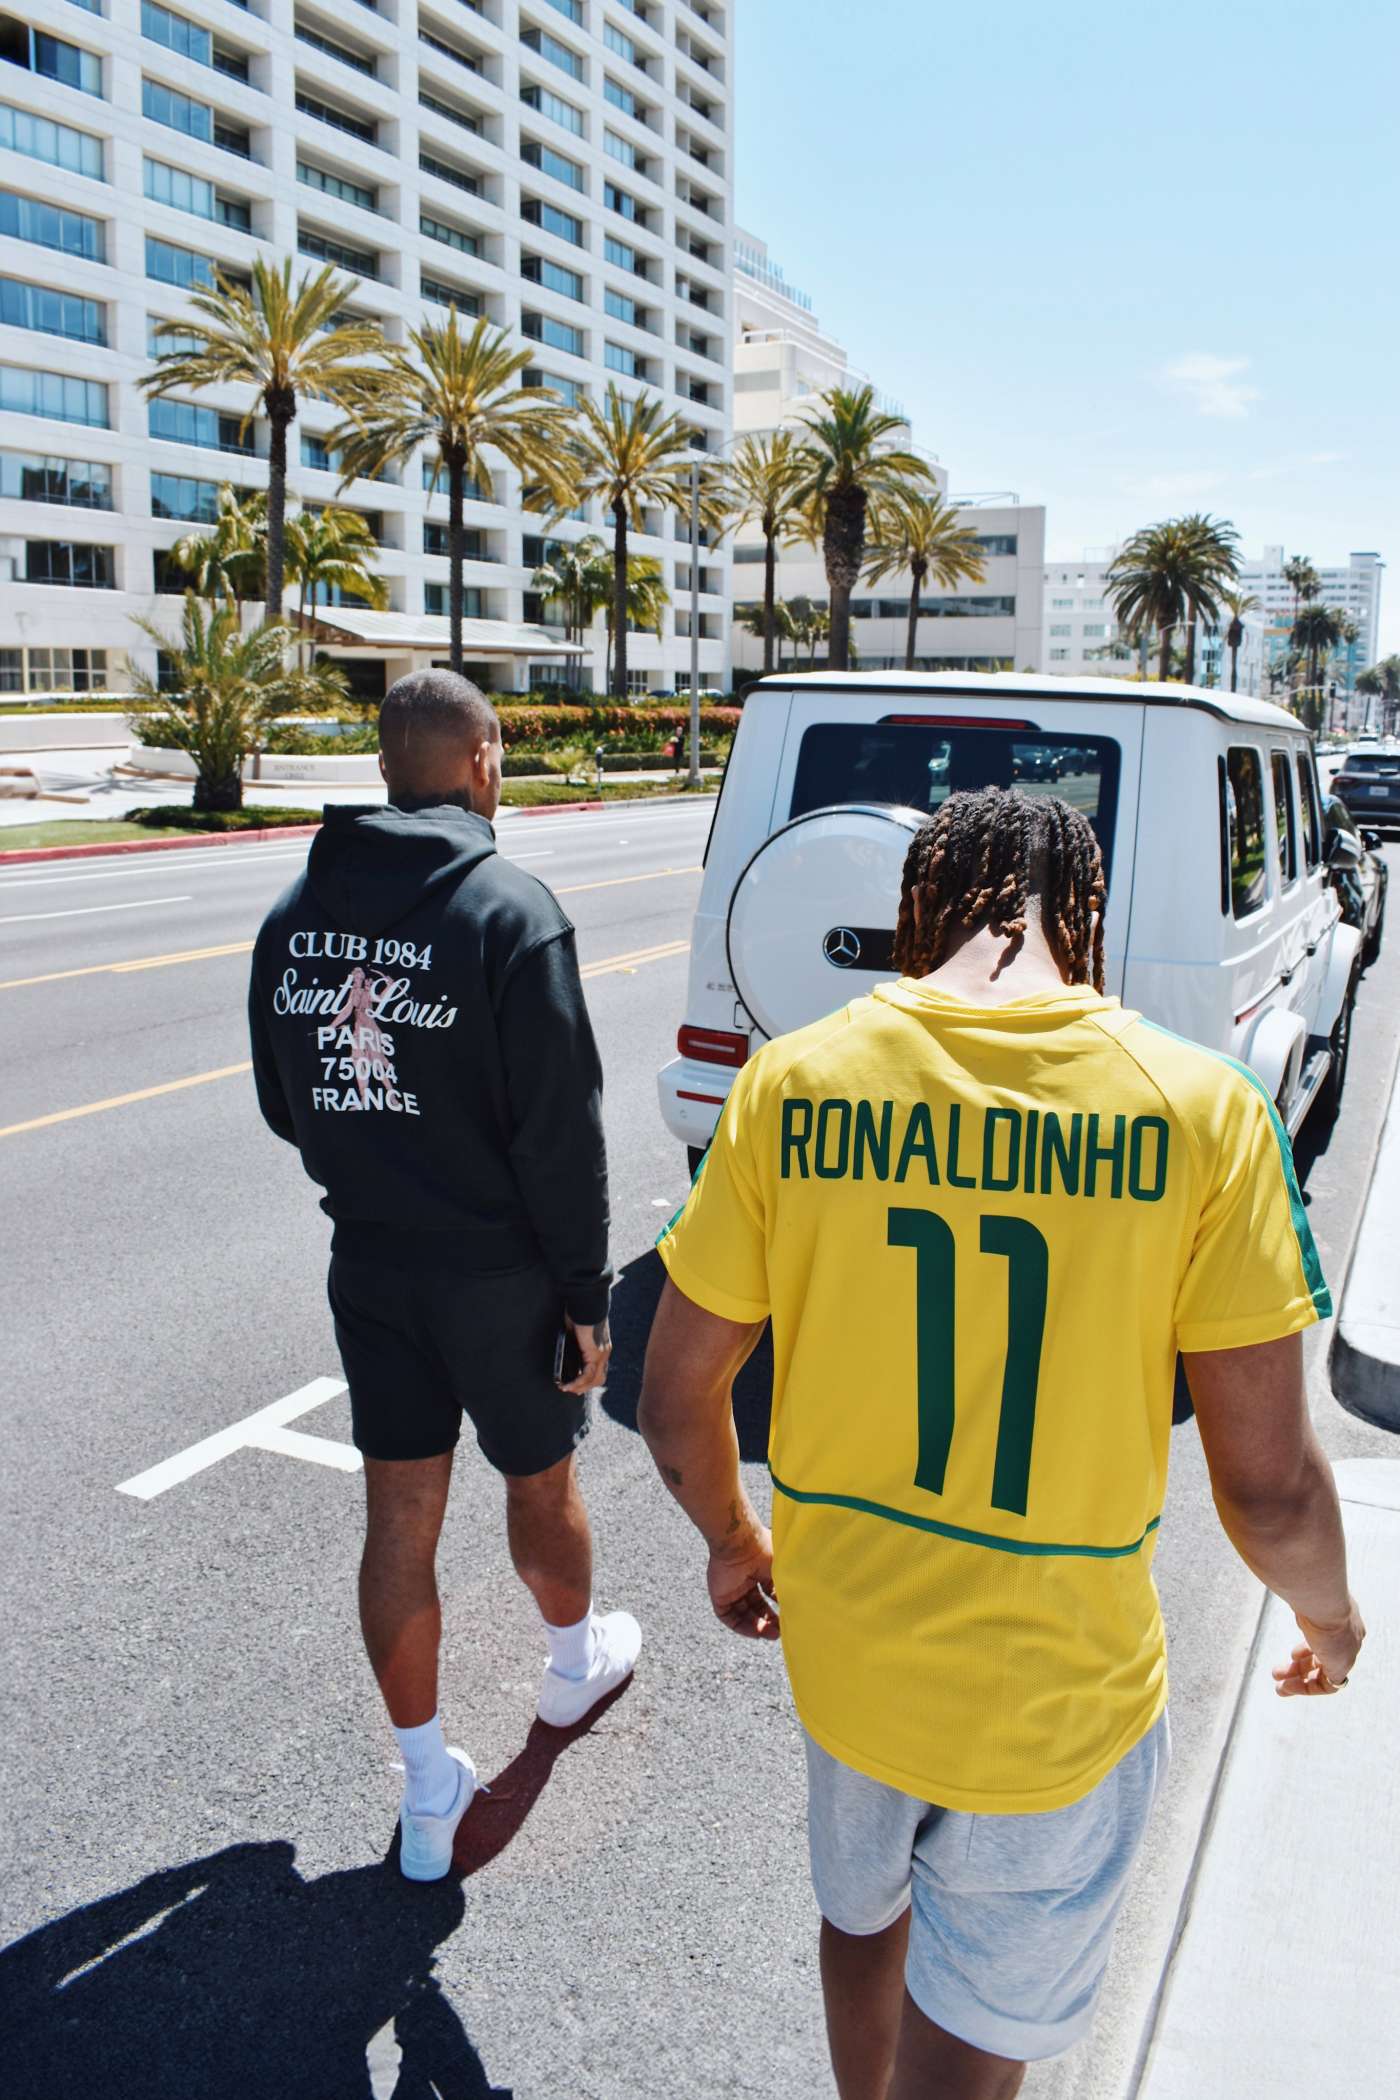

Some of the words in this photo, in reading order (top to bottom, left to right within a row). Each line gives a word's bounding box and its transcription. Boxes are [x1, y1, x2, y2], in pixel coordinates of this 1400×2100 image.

[288, 932, 368, 961] CLUB
[371, 938, 433, 971] 1984
[273, 968, 353, 1015] Saint
[364, 977, 458, 1029] Louis
[317, 1026, 396, 1056] PARIS
[320, 1057, 398, 1084] 75004
[312, 1087, 421, 1116] FRANCE
[780, 1098, 1170, 1202] RONALDINHO
[887, 1206, 1050, 1518] 11
